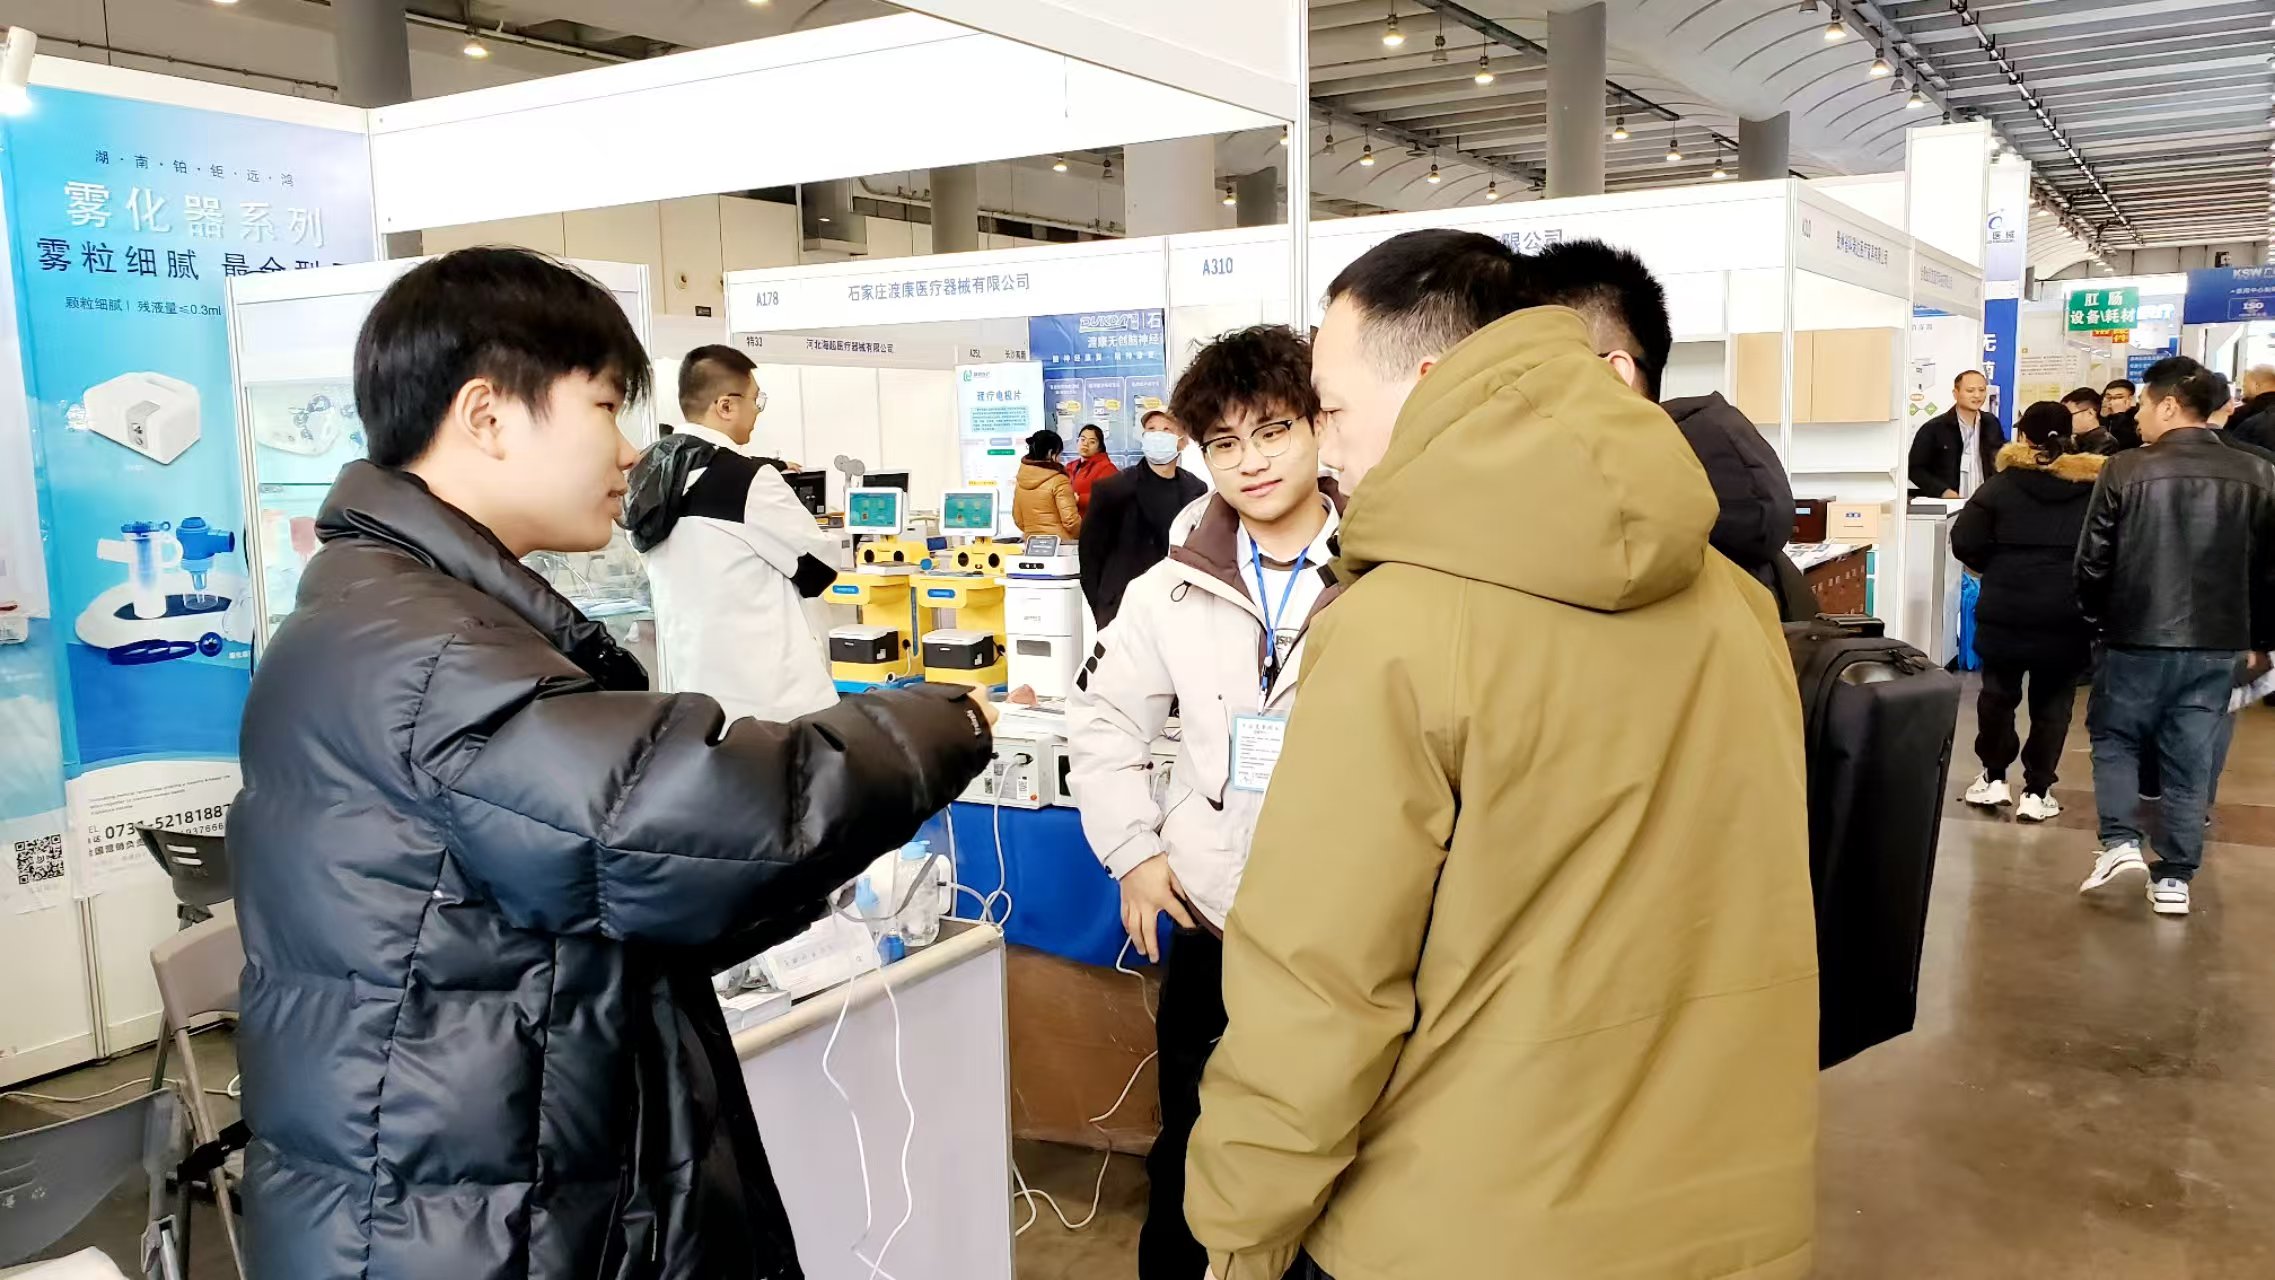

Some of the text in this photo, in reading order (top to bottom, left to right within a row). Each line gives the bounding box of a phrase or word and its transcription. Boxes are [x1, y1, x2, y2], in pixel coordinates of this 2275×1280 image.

[64, 180, 326, 249] 雾化器系列
[36, 238, 200, 281] 雾粒细腻
[1202, 257, 1234, 276] A310
[2232, 268, 2263, 280] KSW
[847, 272, 1031, 302] 石家庄渡康医疗器械有限公司
[756, 290, 780, 307] A178
[2084, 290, 2124, 307] 肛肠
[2242, 302, 2265, 310] ISO
[2070, 307, 2136, 325] 设备\耗材
